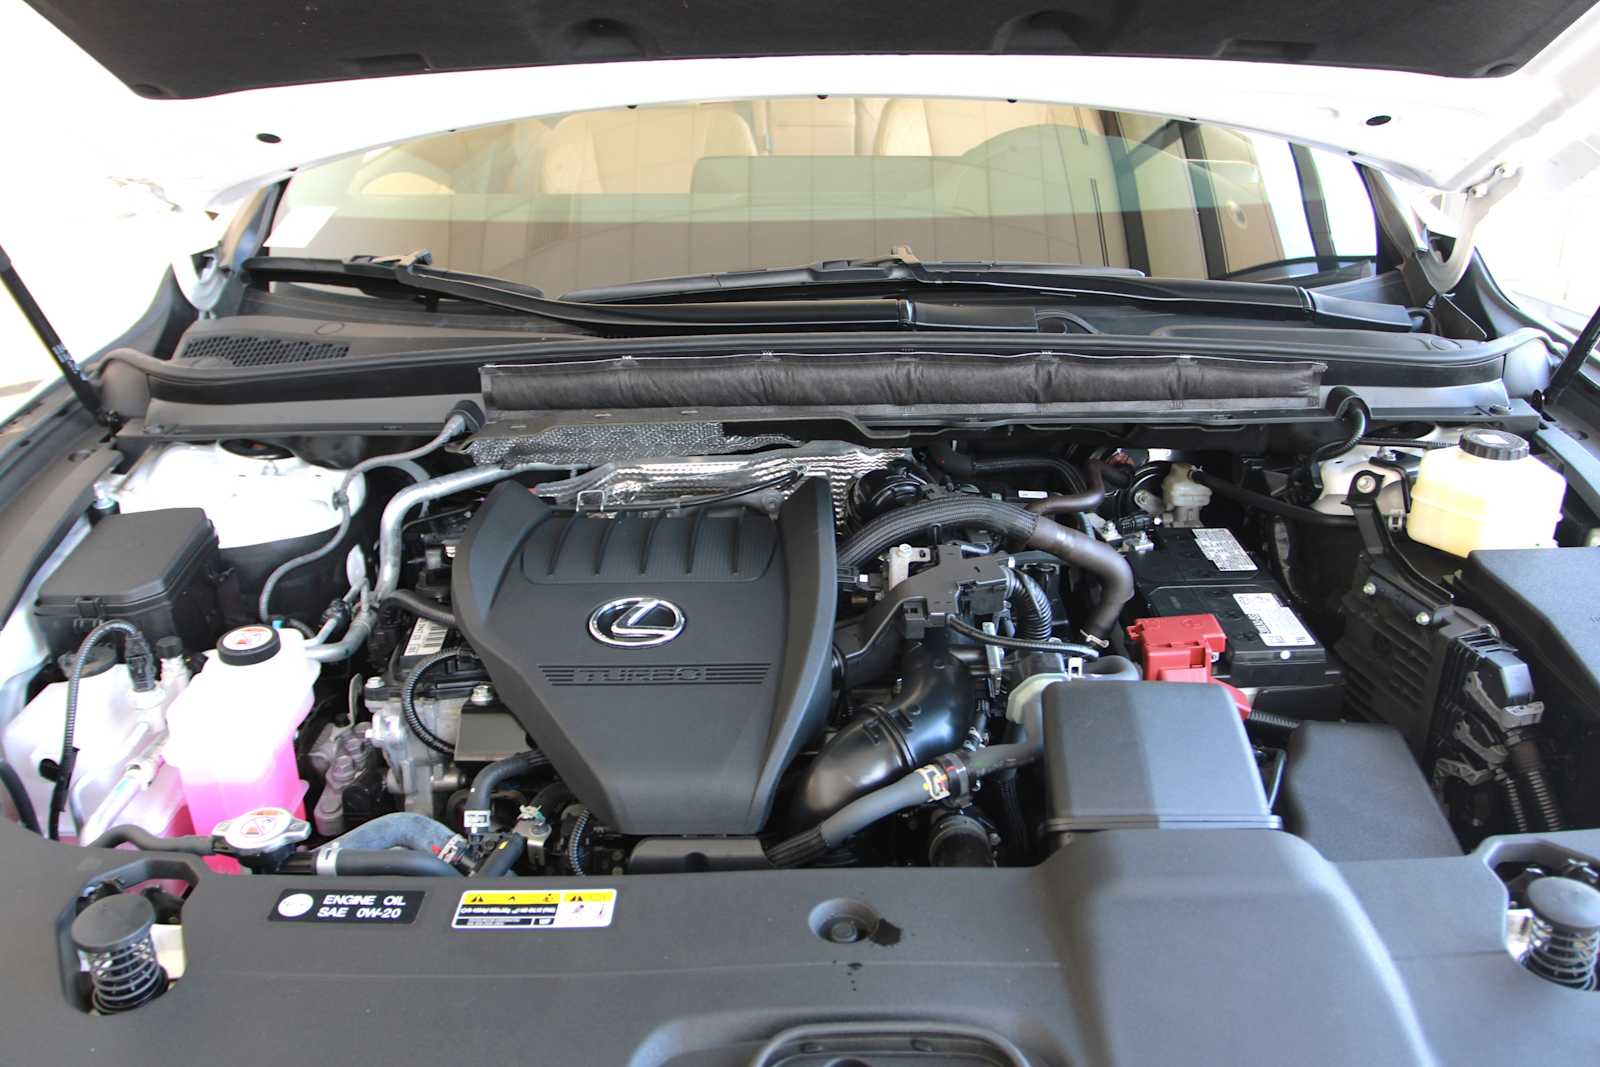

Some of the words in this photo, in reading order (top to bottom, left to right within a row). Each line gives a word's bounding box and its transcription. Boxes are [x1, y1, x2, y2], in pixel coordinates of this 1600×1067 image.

[579, 668, 702, 681] TURBO
[323, 895, 376, 905] ENGINE
[383, 895, 406, 905] OIL
[317, 907, 349, 918] SAE
[356, 908, 402, 918] 0W-20
